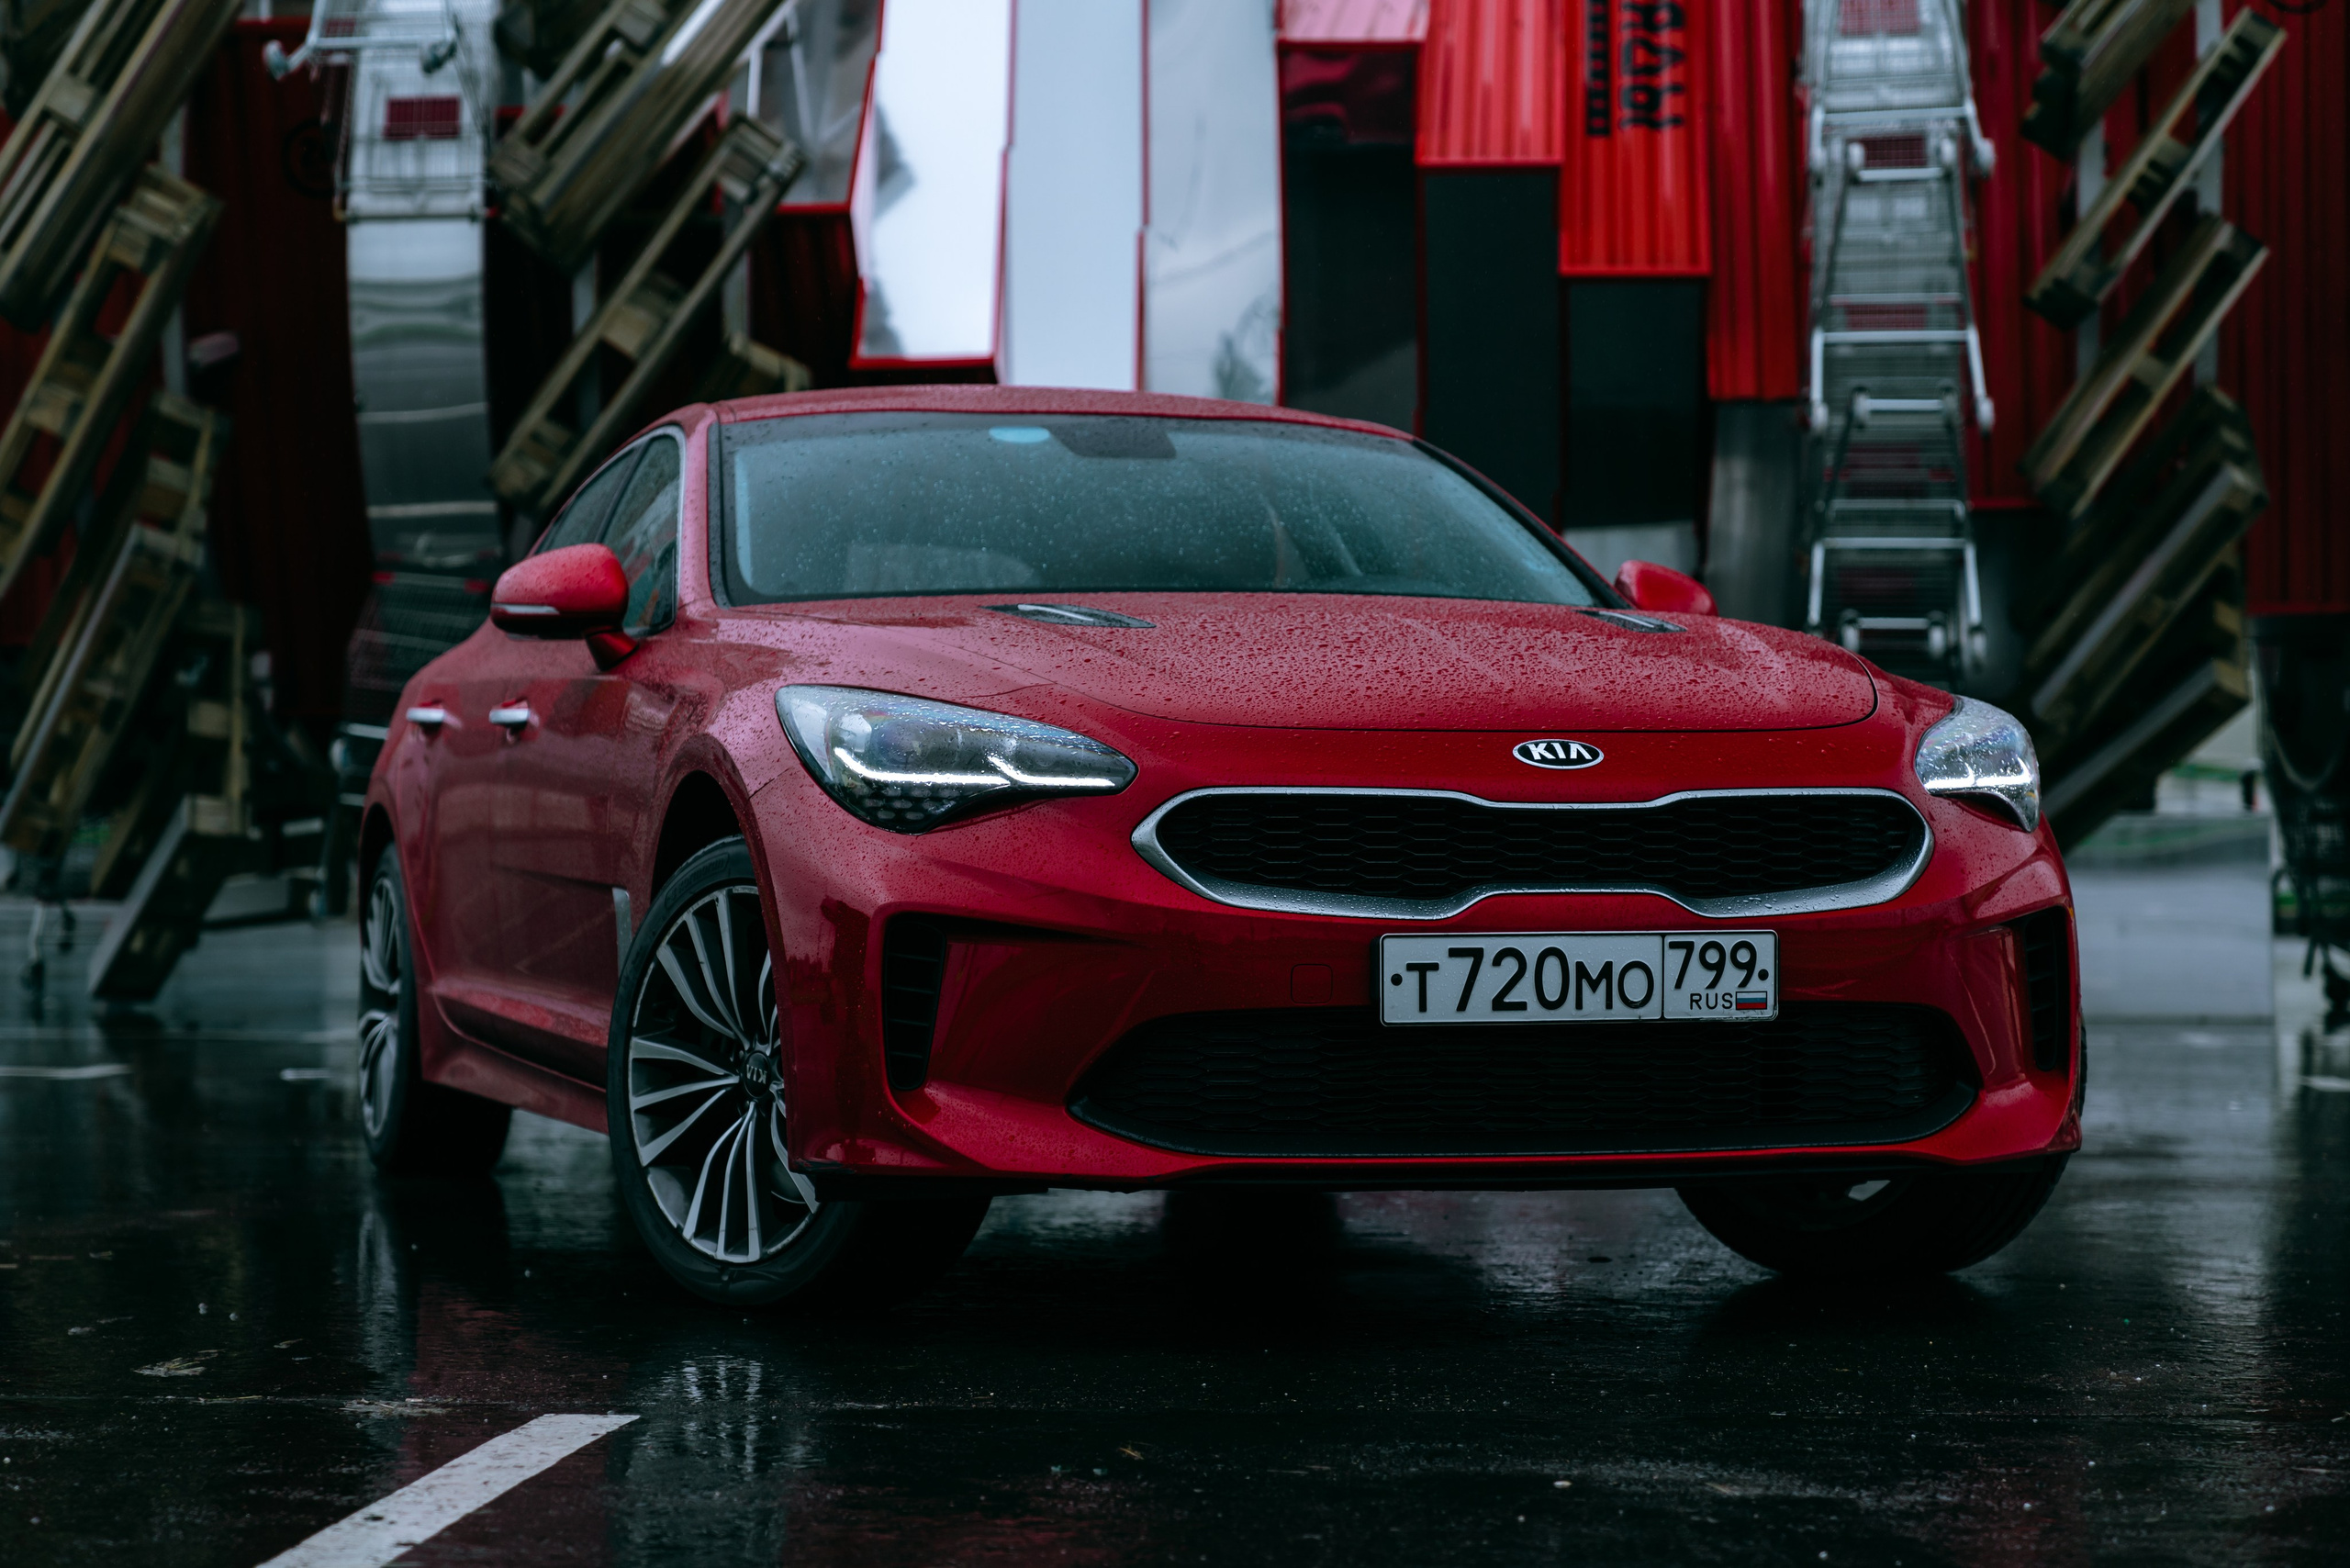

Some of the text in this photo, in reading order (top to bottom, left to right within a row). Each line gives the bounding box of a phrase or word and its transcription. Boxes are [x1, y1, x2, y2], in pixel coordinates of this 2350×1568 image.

[1526, 742, 1593, 760] KIA
[1668, 939, 1758, 990] 799
[1690, 991, 1733, 1011] RUS
[746, 1065, 767, 1084] KIA
